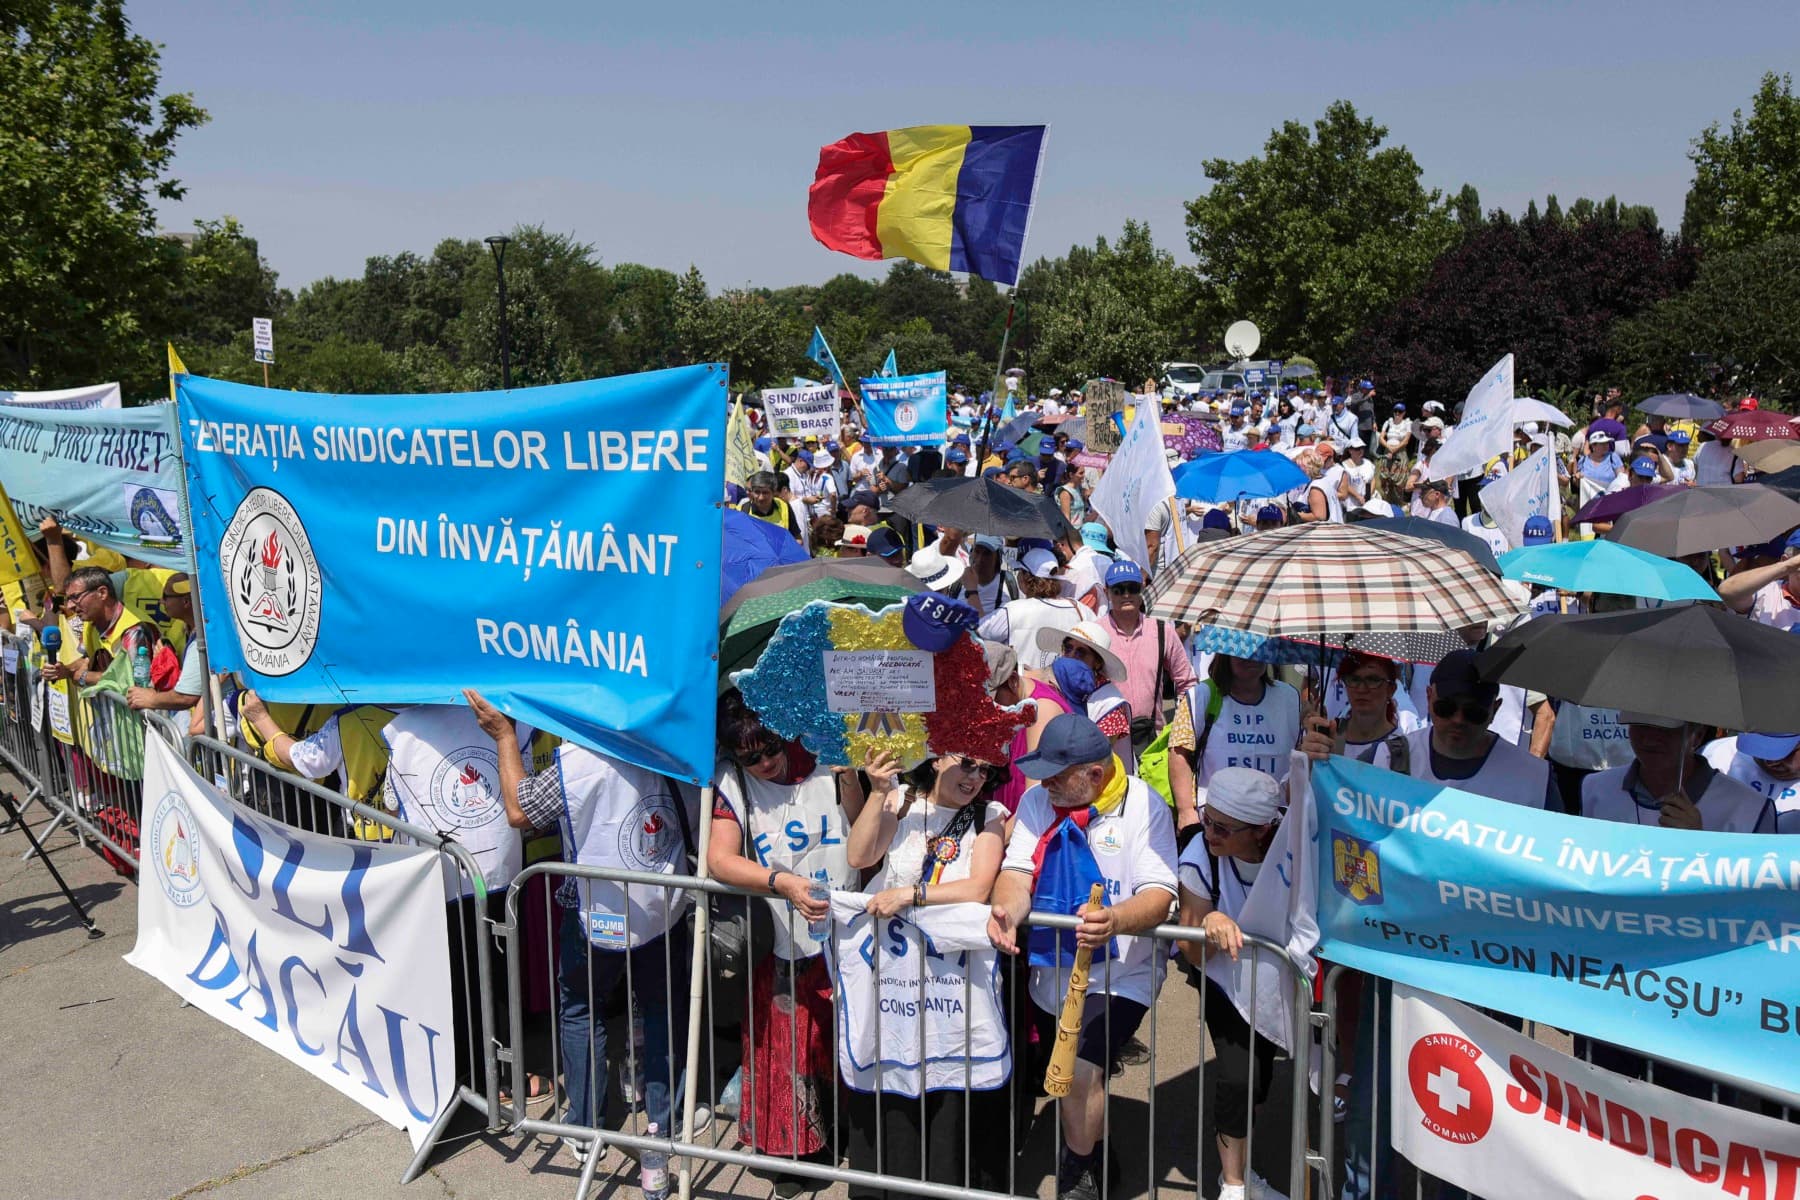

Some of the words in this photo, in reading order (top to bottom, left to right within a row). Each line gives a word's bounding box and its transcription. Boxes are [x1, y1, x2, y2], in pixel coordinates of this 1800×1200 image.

[312, 425, 550, 470] SINDICATELOR
[563, 429, 709, 472] LIBERE
[376, 517, 427, 557] DIN
[439, 512, 678, 582] ÎNVĂȚĂMÂNT
[920, 596, 963, 624] FSLI
[476, 618, 648, 678] ROMÂNIA
[1227, 733, 1275, 745] BUZAU
[1333, 786, 1545, 864] SINDICATUL
[592, 918, 624, 931] DGJMB
[1438, 879, 1800, 954] PREUNIVERSITAR
[1365, 917, 1460, 955] “Prof.
[1472, 939, 1536, 973] ION
[1552, 951, 1743, 1018] NEACȘU”
[1760, 998, 1800, 1037] B
[880, 997, 964, 1018] CONSTANȚA
[1425, 1036, 1477, 1058] SANITAS
[1423, 1117, 1479, 1142] ROMANIA
[1506, 1053, 1800, 1200] SINDICAT
